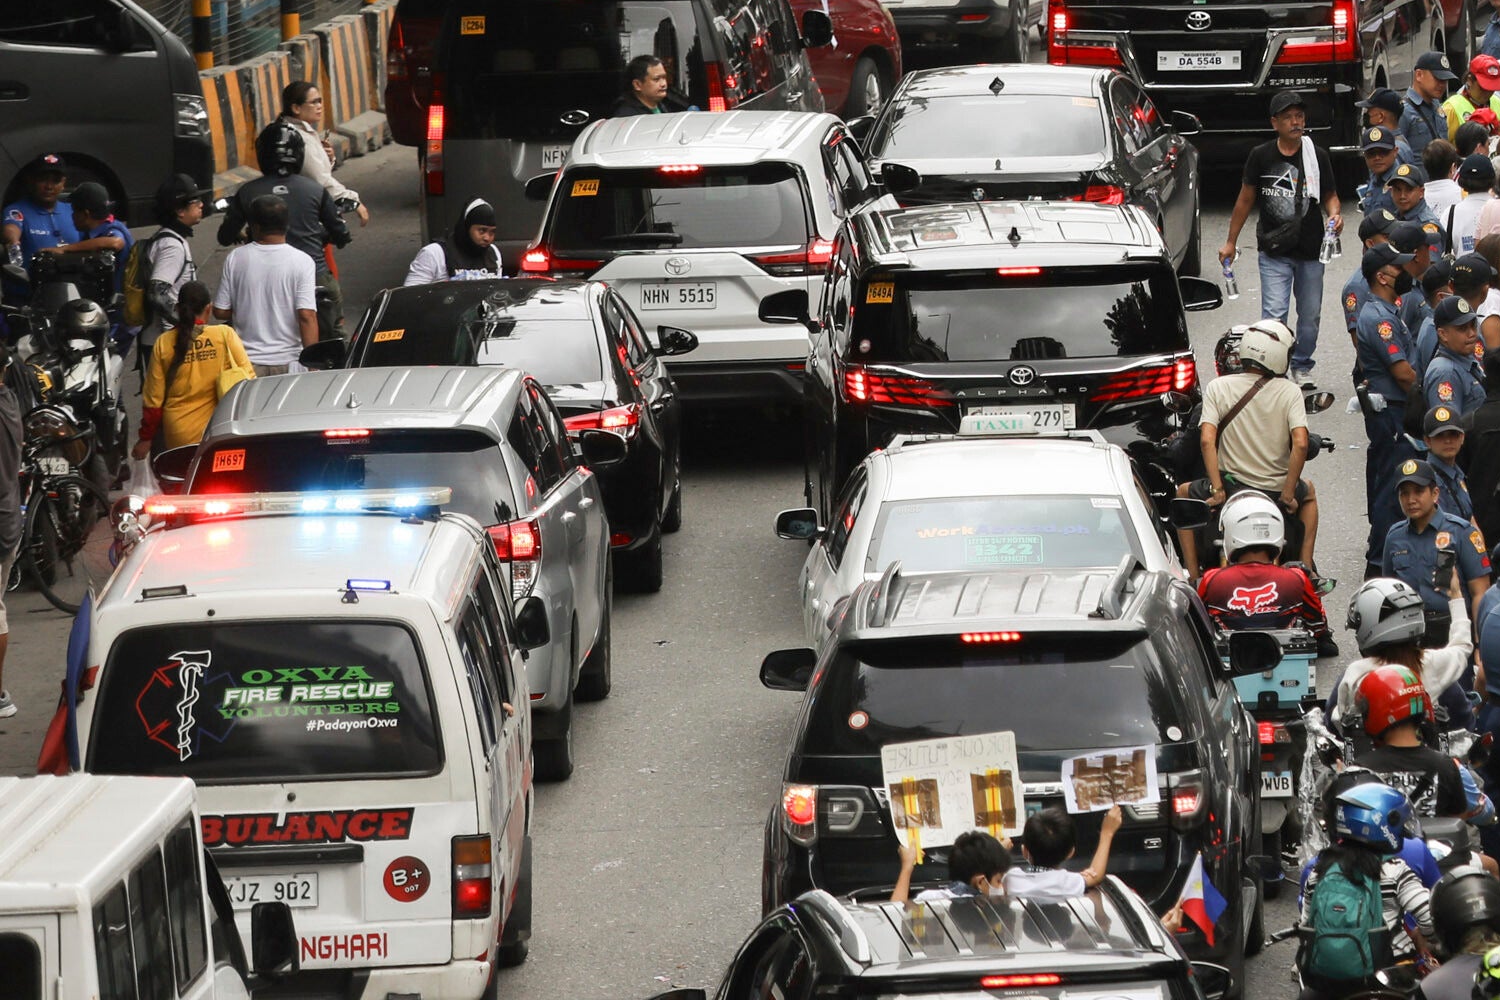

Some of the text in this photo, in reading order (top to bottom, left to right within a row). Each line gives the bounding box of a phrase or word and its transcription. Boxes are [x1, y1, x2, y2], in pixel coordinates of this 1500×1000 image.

[1179, 56, 1222, 66] DA 554B
[643, 288, 714, 304] NHN 5515
[194, 338, 213, 349] DA
[957, 386, 1088, 396] ALPHARD
[972, 419, 1017, 430] TAXI
[1032, 410, 1061, 427] 279
[219, 452, 244, 468] H697
[974, 543, 1033, 557] 1342
[241, 666, 374, 684] OXVA
[222, 680, 394, 708] FIRE RESCUE
[217, 702, 400, 719] VOLUNTEERS
[306, 717, 398, 732] #PadayonOxva
[274, 881, 311, 900] 902
[404, 884, 420, 894] 007
